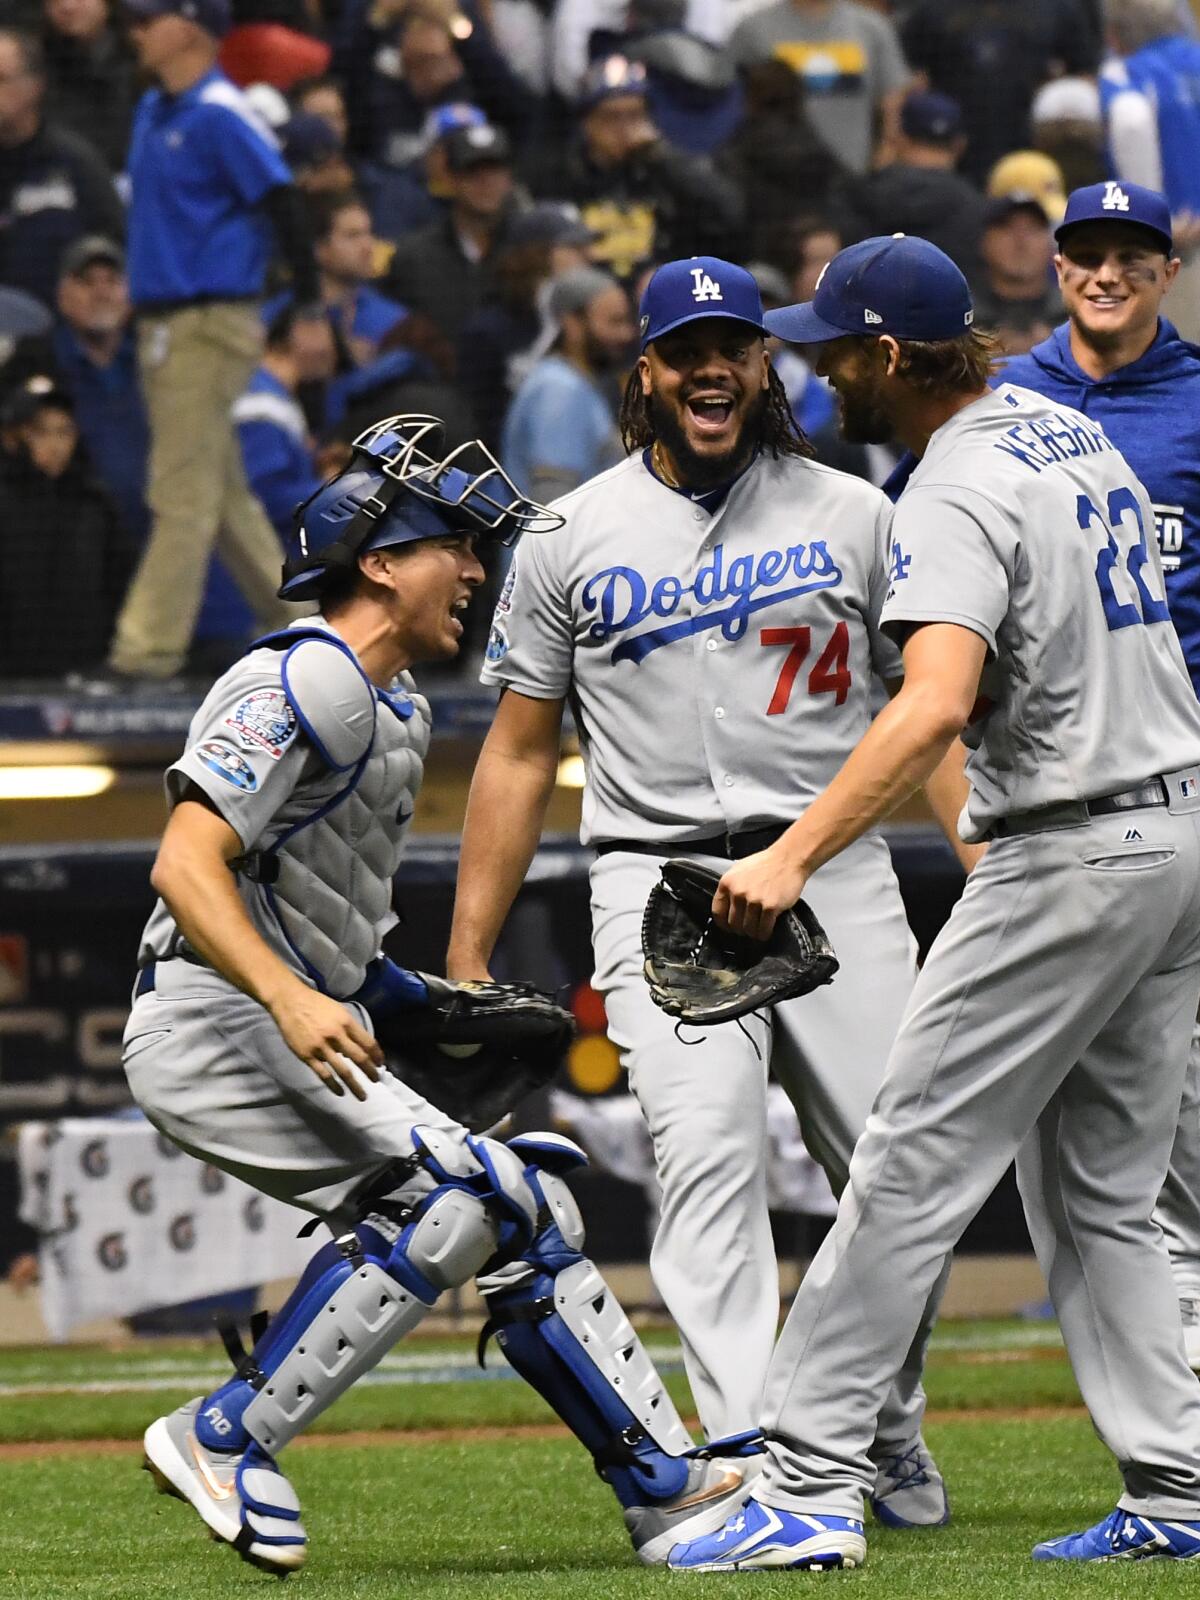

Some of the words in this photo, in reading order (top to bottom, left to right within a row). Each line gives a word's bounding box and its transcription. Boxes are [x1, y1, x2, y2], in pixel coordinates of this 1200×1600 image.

[1102, 181, 1129, 211] LA
[690, 268, 723, 302] LA
[993, 412, 1114, 474] KERSHA
[582, 540, 842, 642] Dodgers
[1076, 486, 1172, 632] 22
[760, 620, 852, 716] 74
